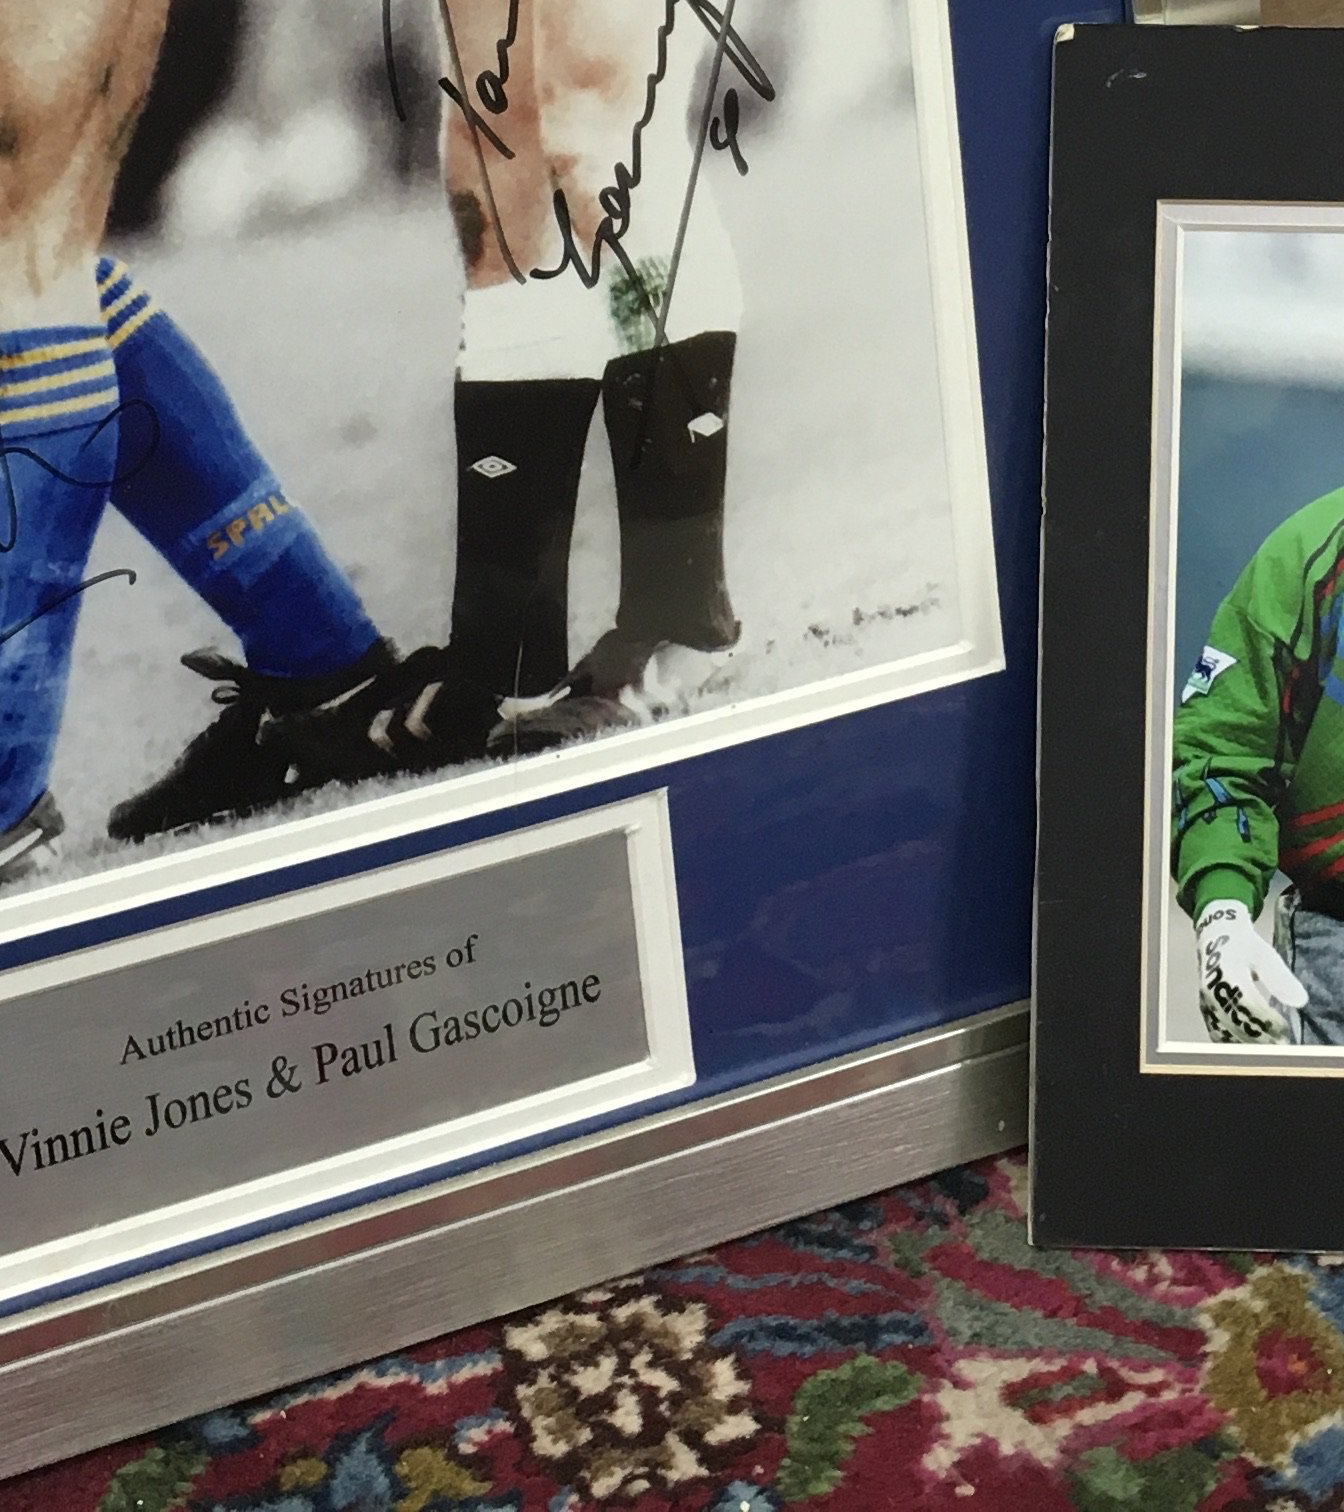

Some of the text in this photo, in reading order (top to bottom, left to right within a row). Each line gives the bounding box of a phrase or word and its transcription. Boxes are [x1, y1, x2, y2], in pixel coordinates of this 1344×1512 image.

[119, 934, 479, 1066] Authentic Signatures of
[143, 1075, 252, 1139] Jones
[263, 1056, 303, 1099] &
[312, 1024, 398, 1086] Paul
[408, 972, 602, 1054] Gascoigne
